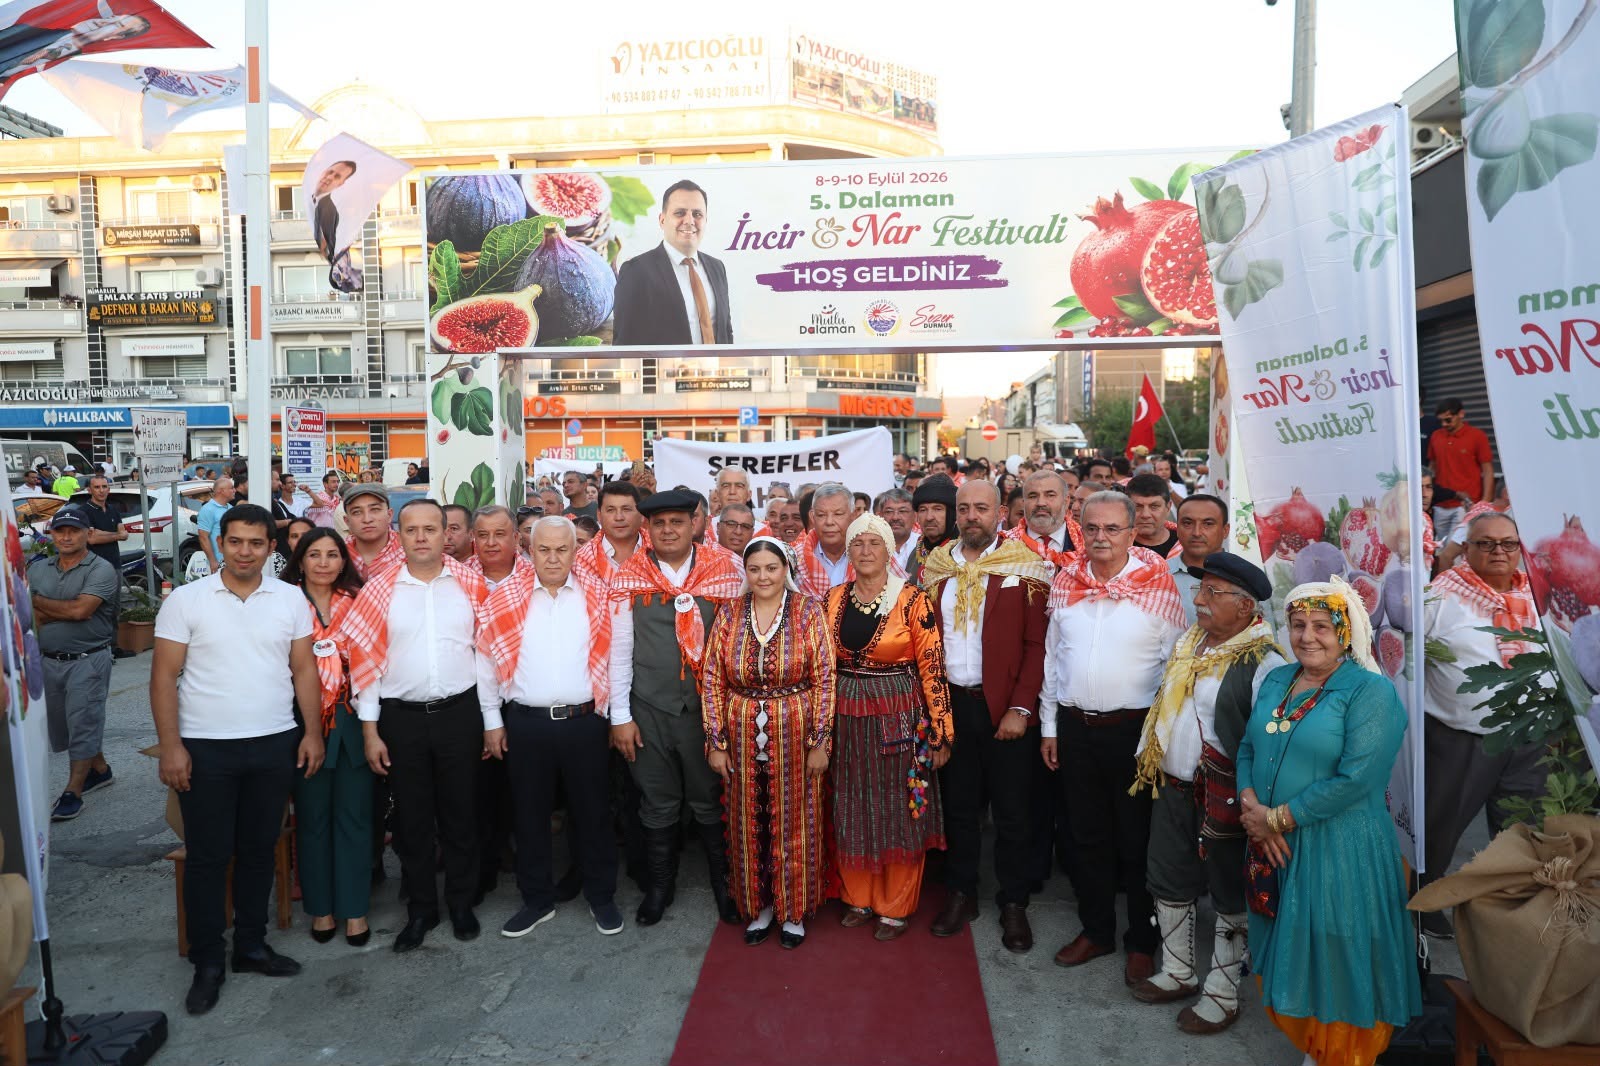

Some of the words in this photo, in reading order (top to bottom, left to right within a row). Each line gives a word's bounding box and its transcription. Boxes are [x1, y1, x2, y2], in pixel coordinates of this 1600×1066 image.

[638, 33, 764, 63] YAZICIOĞLU
[808, 39, 880, 74] YAZICIOĞLU
[815, 174, 863, 187] 8-9-10
[868, 172, 905, 188] Eylül
[909, 172, 948, 184] 2026
[810, 194, 831, 210] 5.
[839, 191, 954, 210] Dalaman
[143, 228, 165, 239] İNŞAAT
[724, 212, 805, 251] İncir
[847, 212, 922, 247] Nar
[930, 213, 1068, 247] Festivali
[794, 266, 847, 289] HOŞ
[853, 260, 971, 284] GELDİNİZ
[99, 293, 135, 301] EMLAK
[140, 292, 169, 301] SATIŞ
[174, 290, 203, 299] OFİSİ
[101, 303, 138, 316] DEFNEM
[141, 303, 147, 315] &
[150, 302, 179, 314] BARAN
[182, 300, 198, 316] İNŞ.
[275, 308, 303, 316] SABANCI
[305, 306, 342, 315] MİMARLIK
[812, 313, 846, 326] Mutlu
[910, 304, 955, 327] Sezer
[800, 325, 856, 335] Dalaman
[84, 387, 140, 398] MÜHENDİSLİK
[59, 411, 124, 423] HALKBANK
[141, 414, 171, 425] Dalaman
[142, 427, 157, 438] Halk
[143, 441, 182, 453] Kütüphanesi
[160, 465, 176, 474] Otopark
